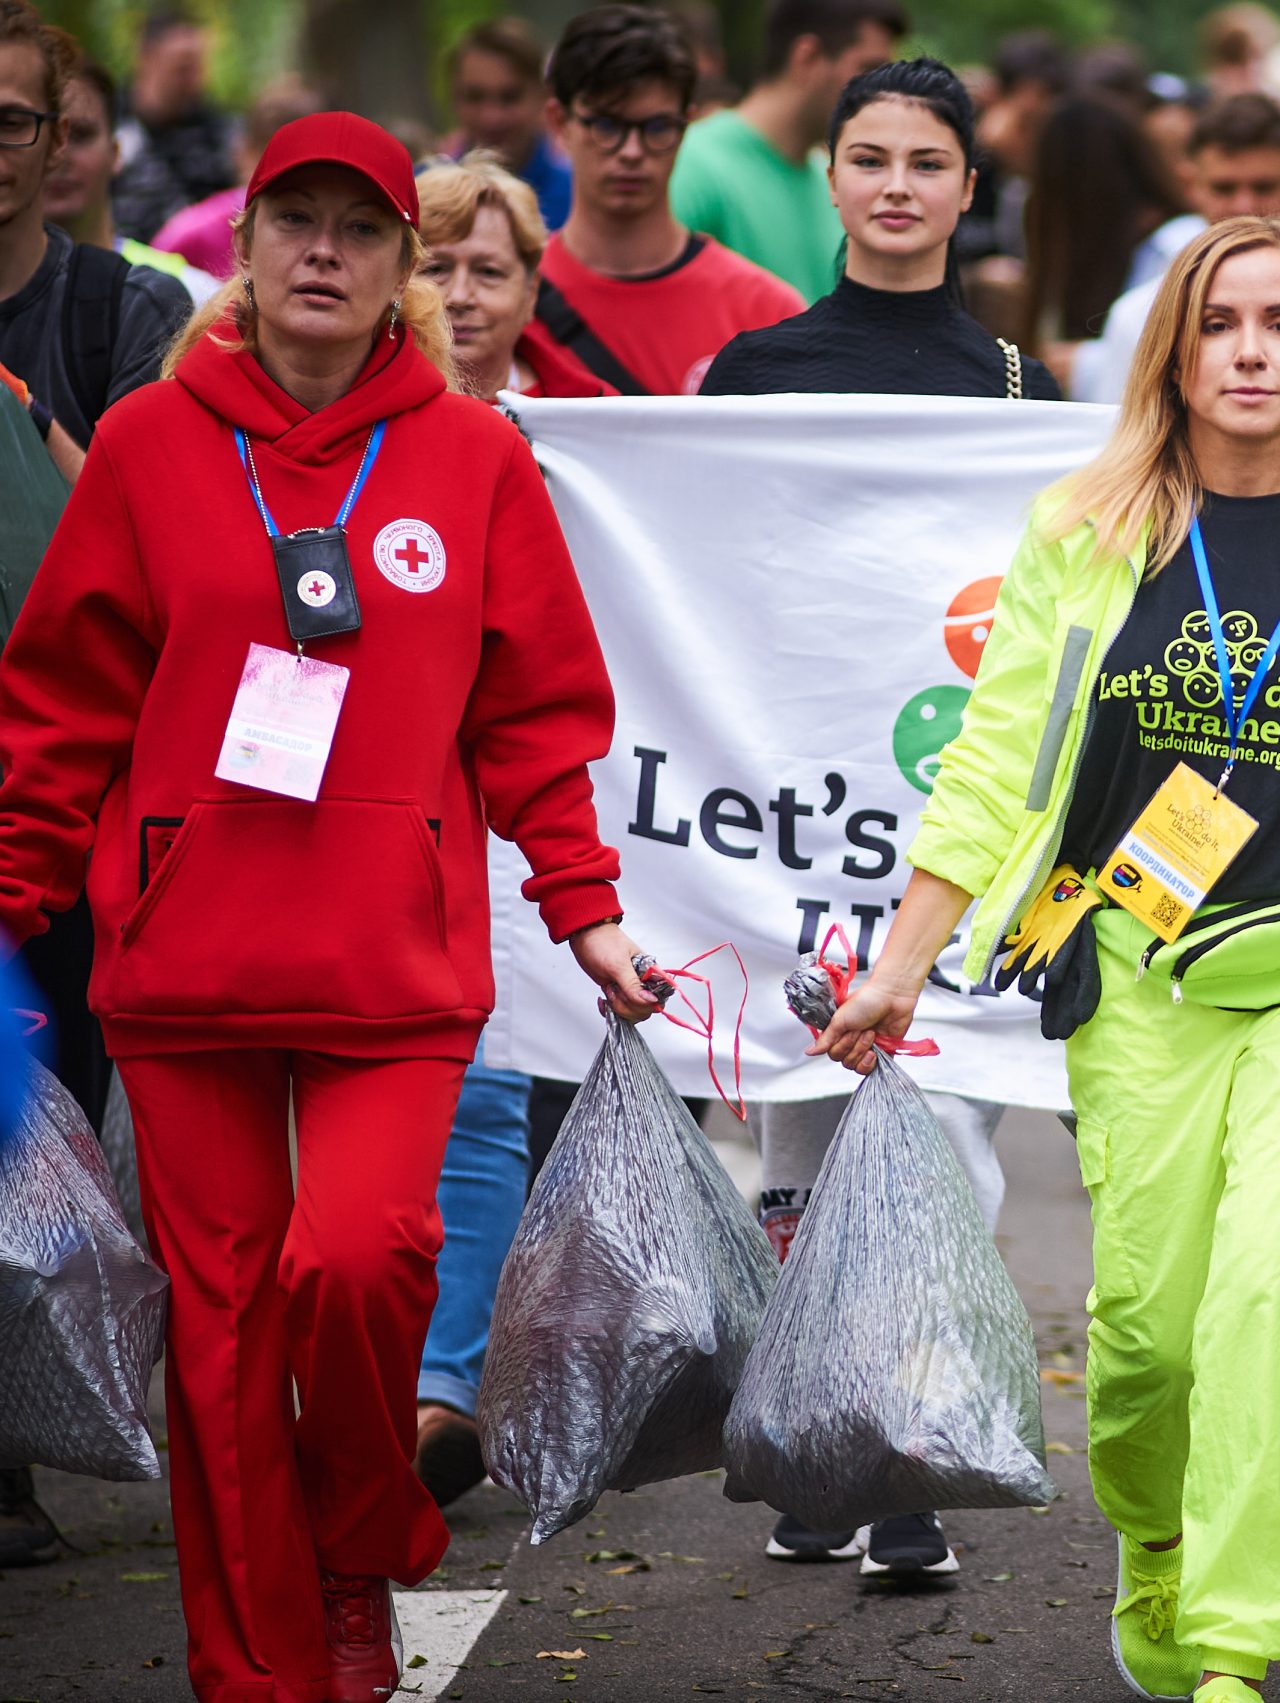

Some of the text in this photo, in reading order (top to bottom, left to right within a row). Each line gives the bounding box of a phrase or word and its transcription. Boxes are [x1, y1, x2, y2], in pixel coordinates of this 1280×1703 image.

[1098, 664, 1169, 701] Let's
[627, 744, 898, 879] Let's
[1128, 841, 1196, 899] КООРДИНАТОР
